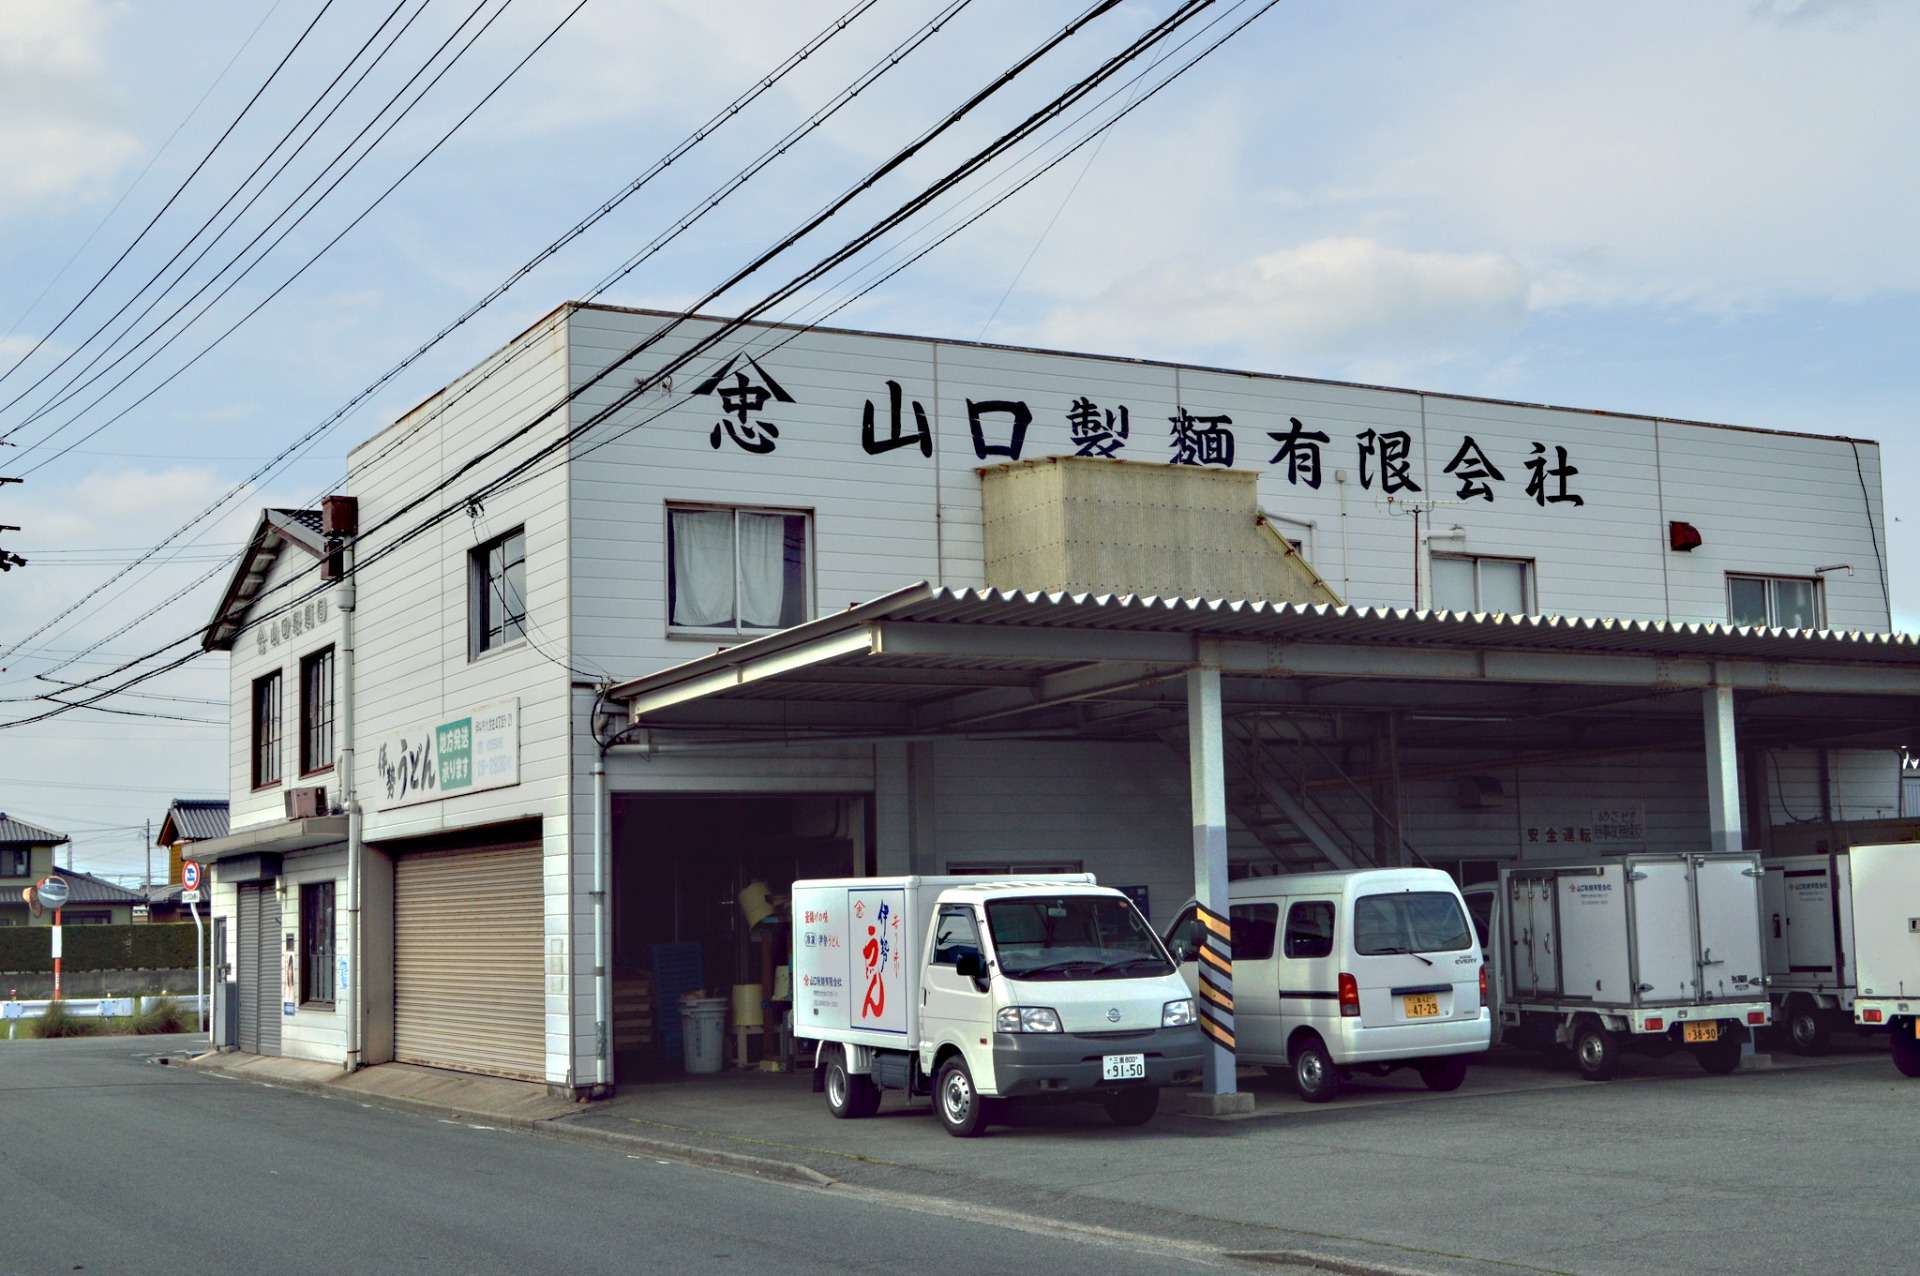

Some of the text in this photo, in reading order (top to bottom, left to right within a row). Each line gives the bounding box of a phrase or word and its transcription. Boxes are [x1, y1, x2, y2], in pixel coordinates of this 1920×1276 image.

[439, 727, 469, 753] 地方発送
[1527, 826, 1592, 843] 安全運転
[1413, 1003, 1438, 1016] 47-25
[1112, 1063, 1143, 1077] 91-50
